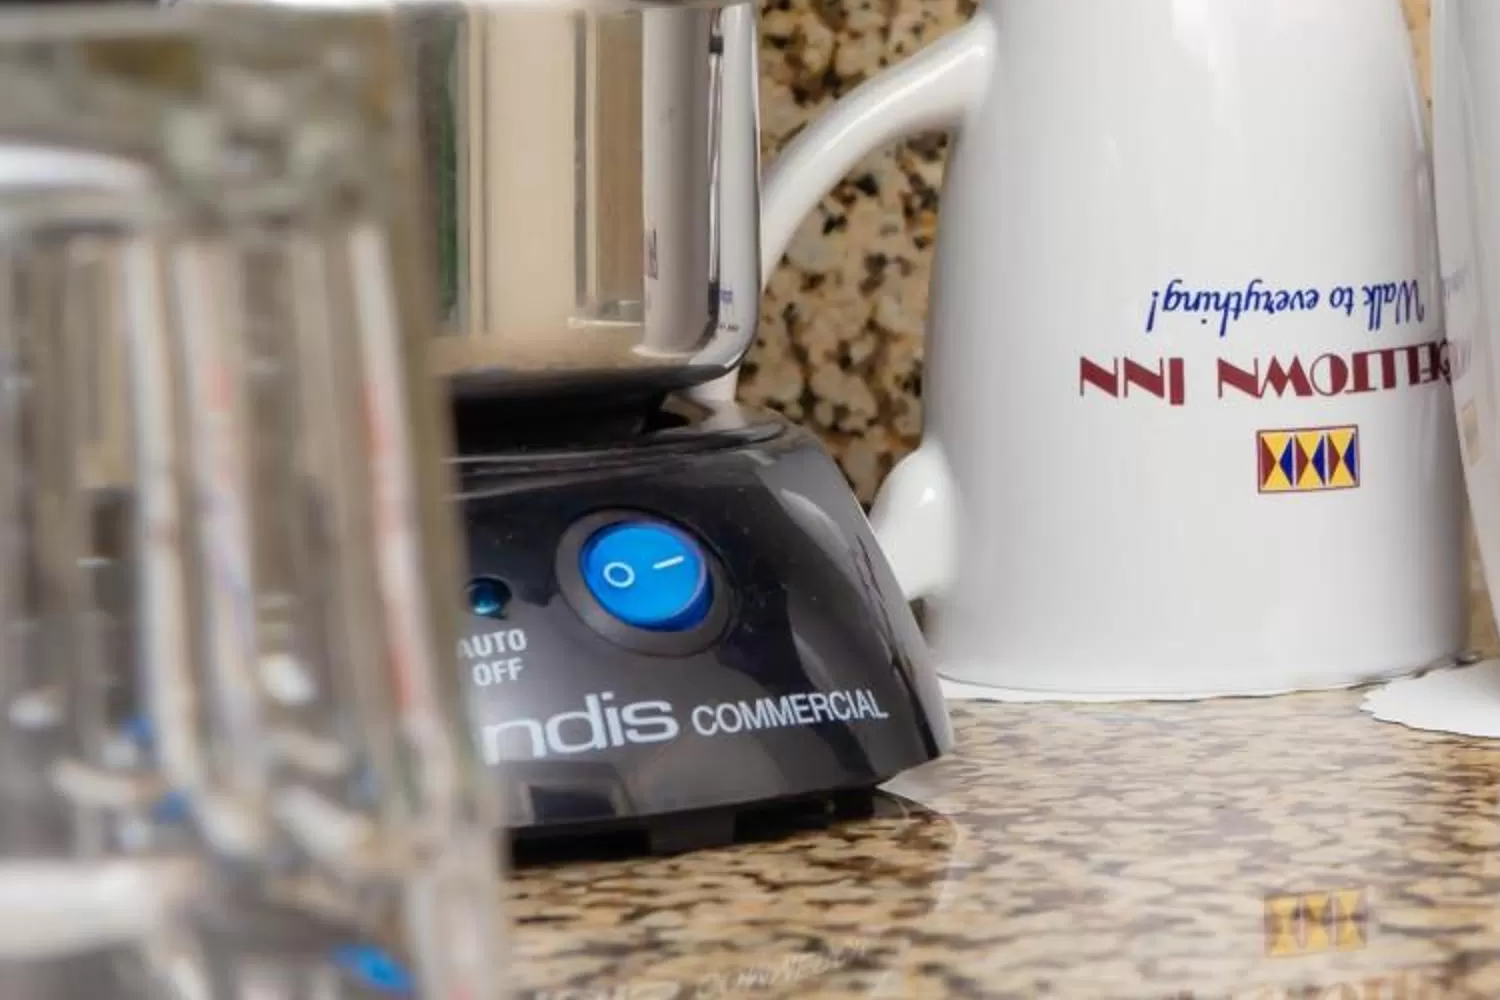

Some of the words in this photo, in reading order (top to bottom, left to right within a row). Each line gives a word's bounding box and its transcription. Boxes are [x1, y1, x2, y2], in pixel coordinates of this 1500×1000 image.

[1146, 279, 1320, 338] everything!
[1329, 287, 1354, 317] to
[1363, 279, 1426, 332] Walk
[1079, 355, 1186, 407] INN
[457, 628, 528, 659] AUTO
[472, 657, 525, 687] OFF
[480, 690, 681, 766] ndis
[691, 688, 890, 738] COMMERCIAL
